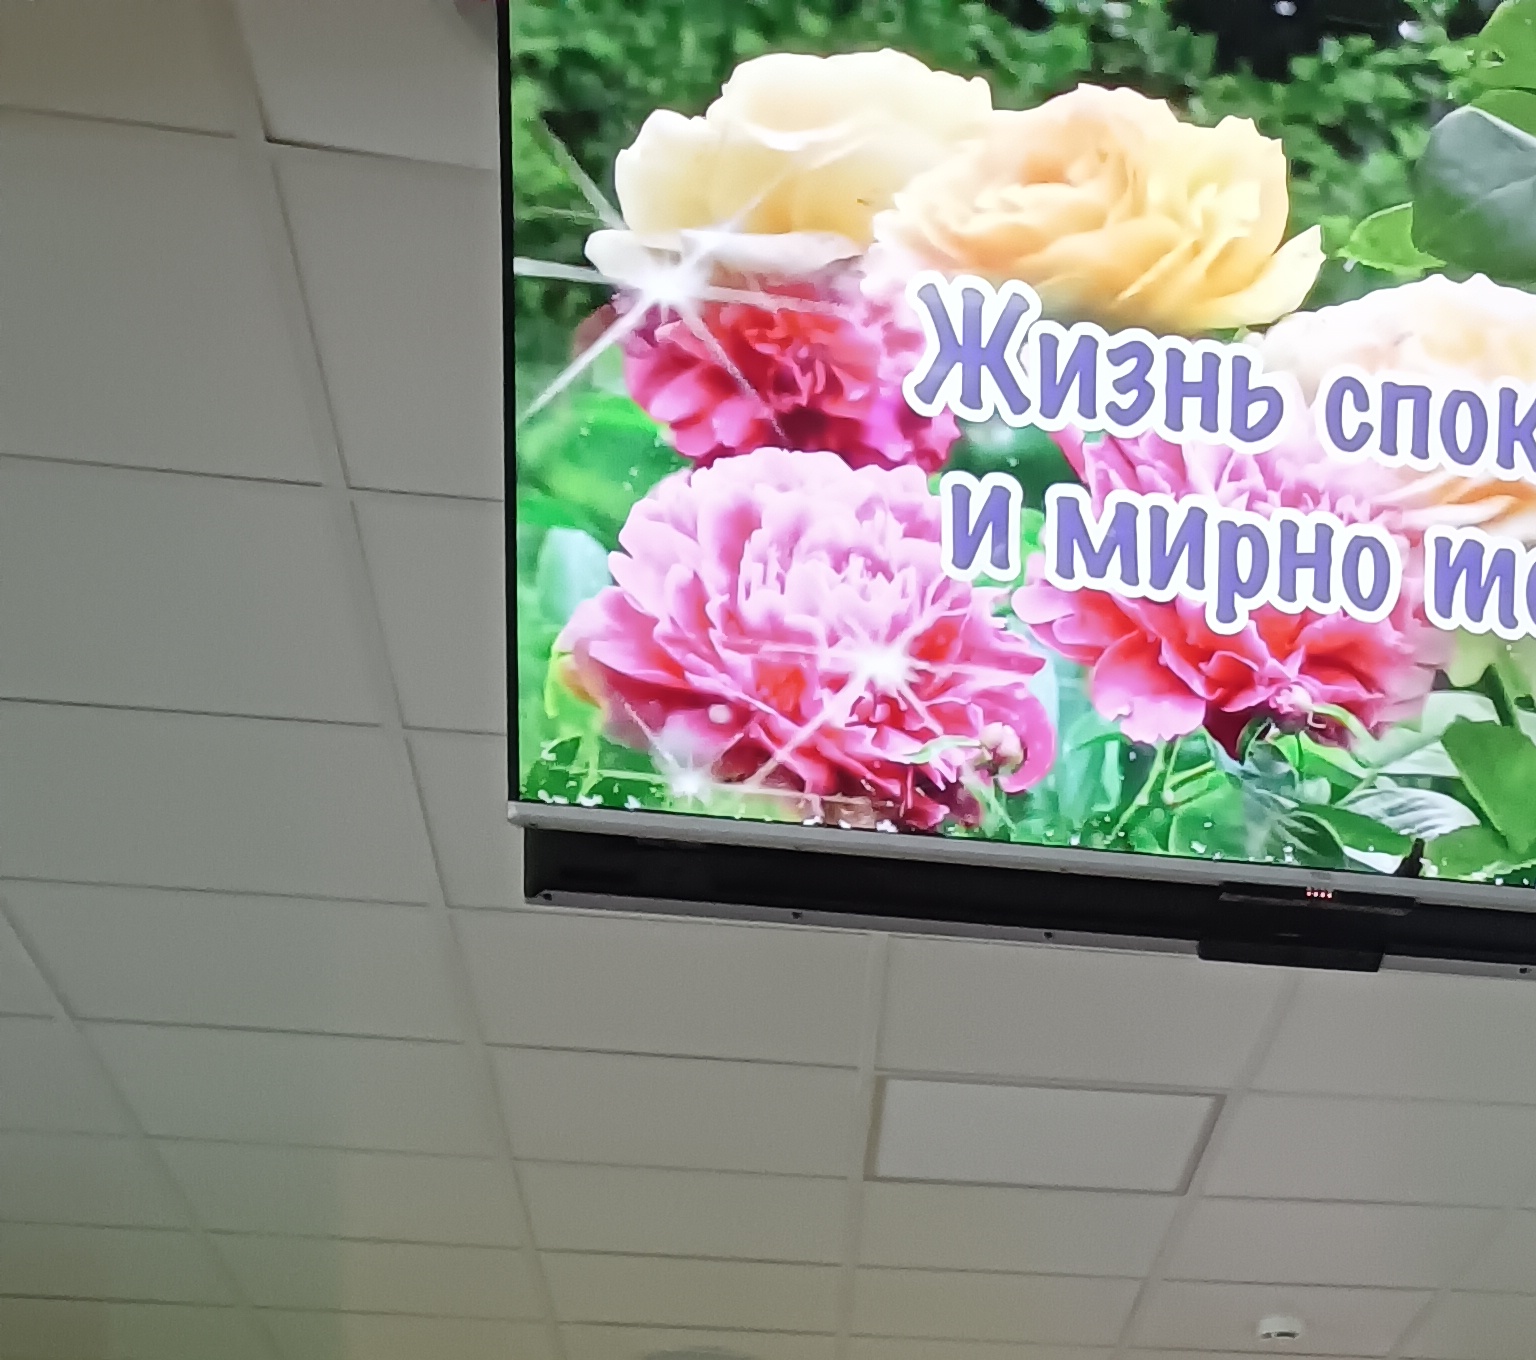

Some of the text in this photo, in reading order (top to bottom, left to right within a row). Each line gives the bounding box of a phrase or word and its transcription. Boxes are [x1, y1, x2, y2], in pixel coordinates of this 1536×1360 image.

[914, 282, 1284, 442] Жизнь
[951, 484, 1012, 570] и
[1056, 496, 1391, 623] мирно
